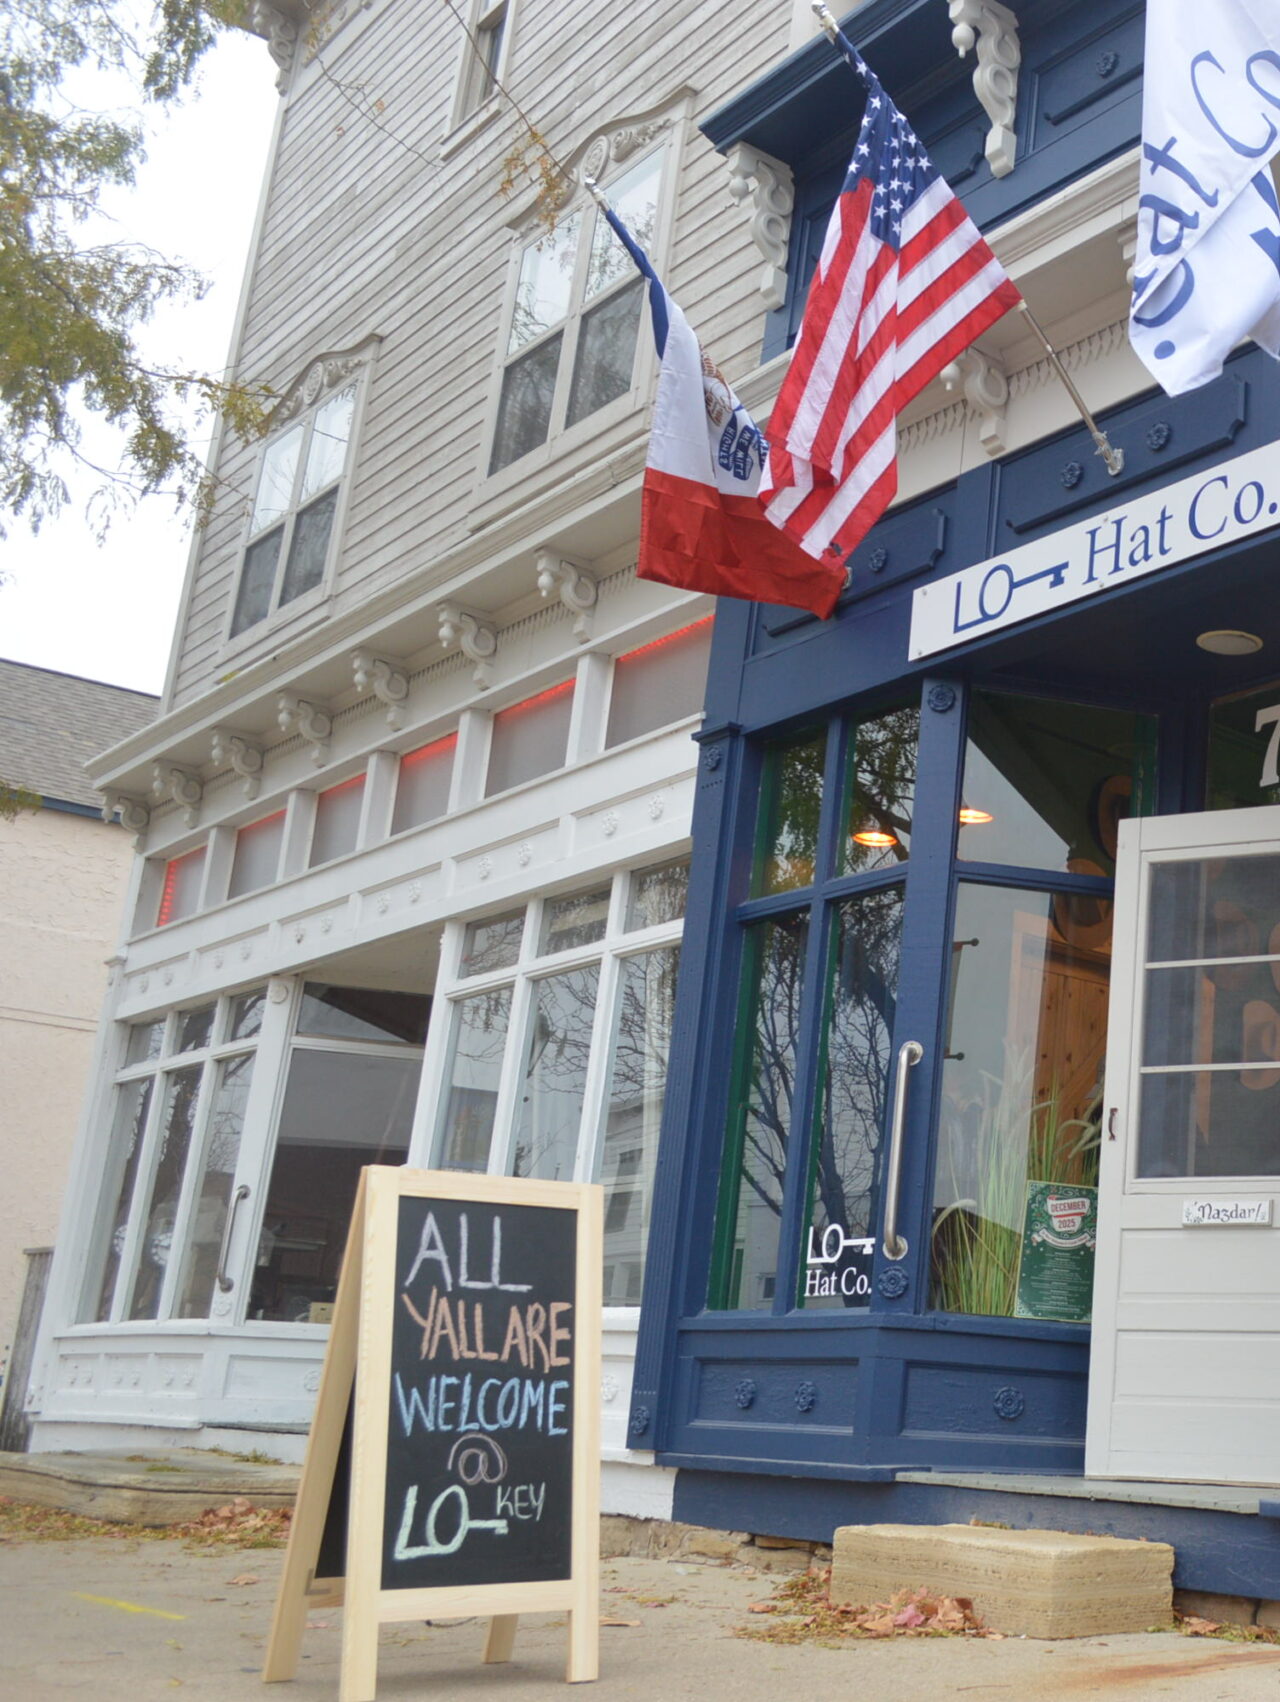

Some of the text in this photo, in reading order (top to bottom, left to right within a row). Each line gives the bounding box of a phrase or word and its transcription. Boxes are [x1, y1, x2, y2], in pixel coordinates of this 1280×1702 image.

[1132, 137, 1218, 307] at
[1082, 505, 1174, 585] Hat
[1188, 475, 1278, 540] Co.
[1050, 1200, 1087, 1213] DECEMBER
[1057, 1219, 1076, 1229] 2025
[405, 1210, 533, 1292] ALL
[804, 1266, 872, 1297] Hat Co.
[402, 1285, 572, 1373] YALL ARE
[394, 1372, 571, 1437] WELCOME
[446, 1432, 508, 1485] @
[496, 1482, 546, 1521] KEY
